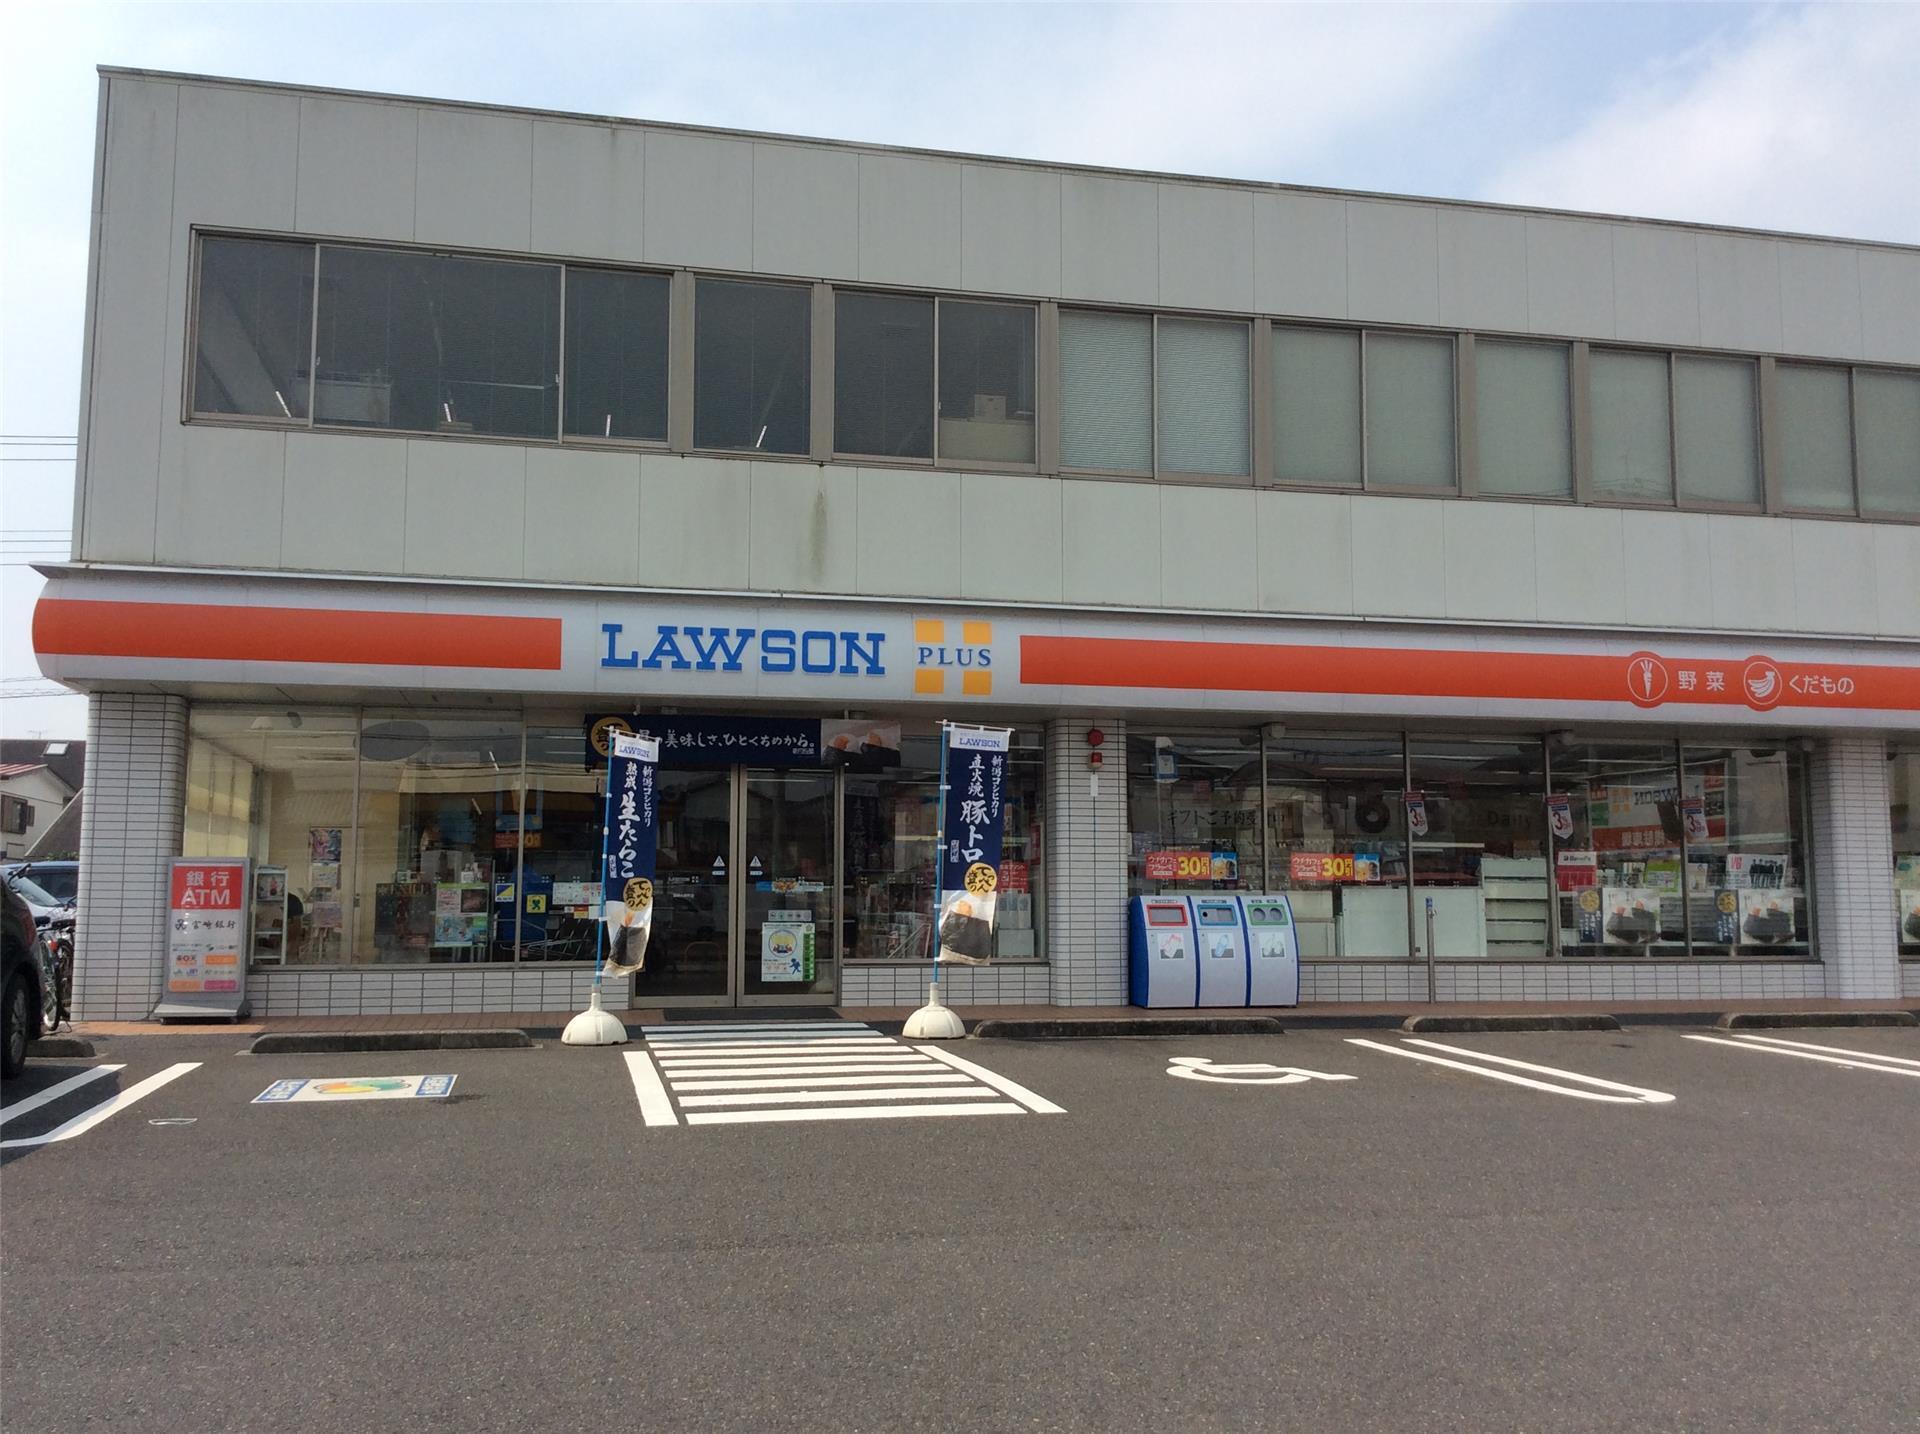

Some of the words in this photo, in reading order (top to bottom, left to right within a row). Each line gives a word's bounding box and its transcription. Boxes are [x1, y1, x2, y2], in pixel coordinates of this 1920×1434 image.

[601, 623, 886, 675] LAWSON
[917, 646, 992, 667] PLUS
[1677, 670, 1726, 692] 野菜
[1788, 675, 1855, 695] くだもの
[638, 729, 815, 749] 美味しさ、ひとくちめから。
[959, 737, 1001, 748] LAWSON
[990, 755, 1003, 818] 新潟コシヒカリ
[185, 870, 230, 887] 銀行
[180, 888, 231, 906] ATM
